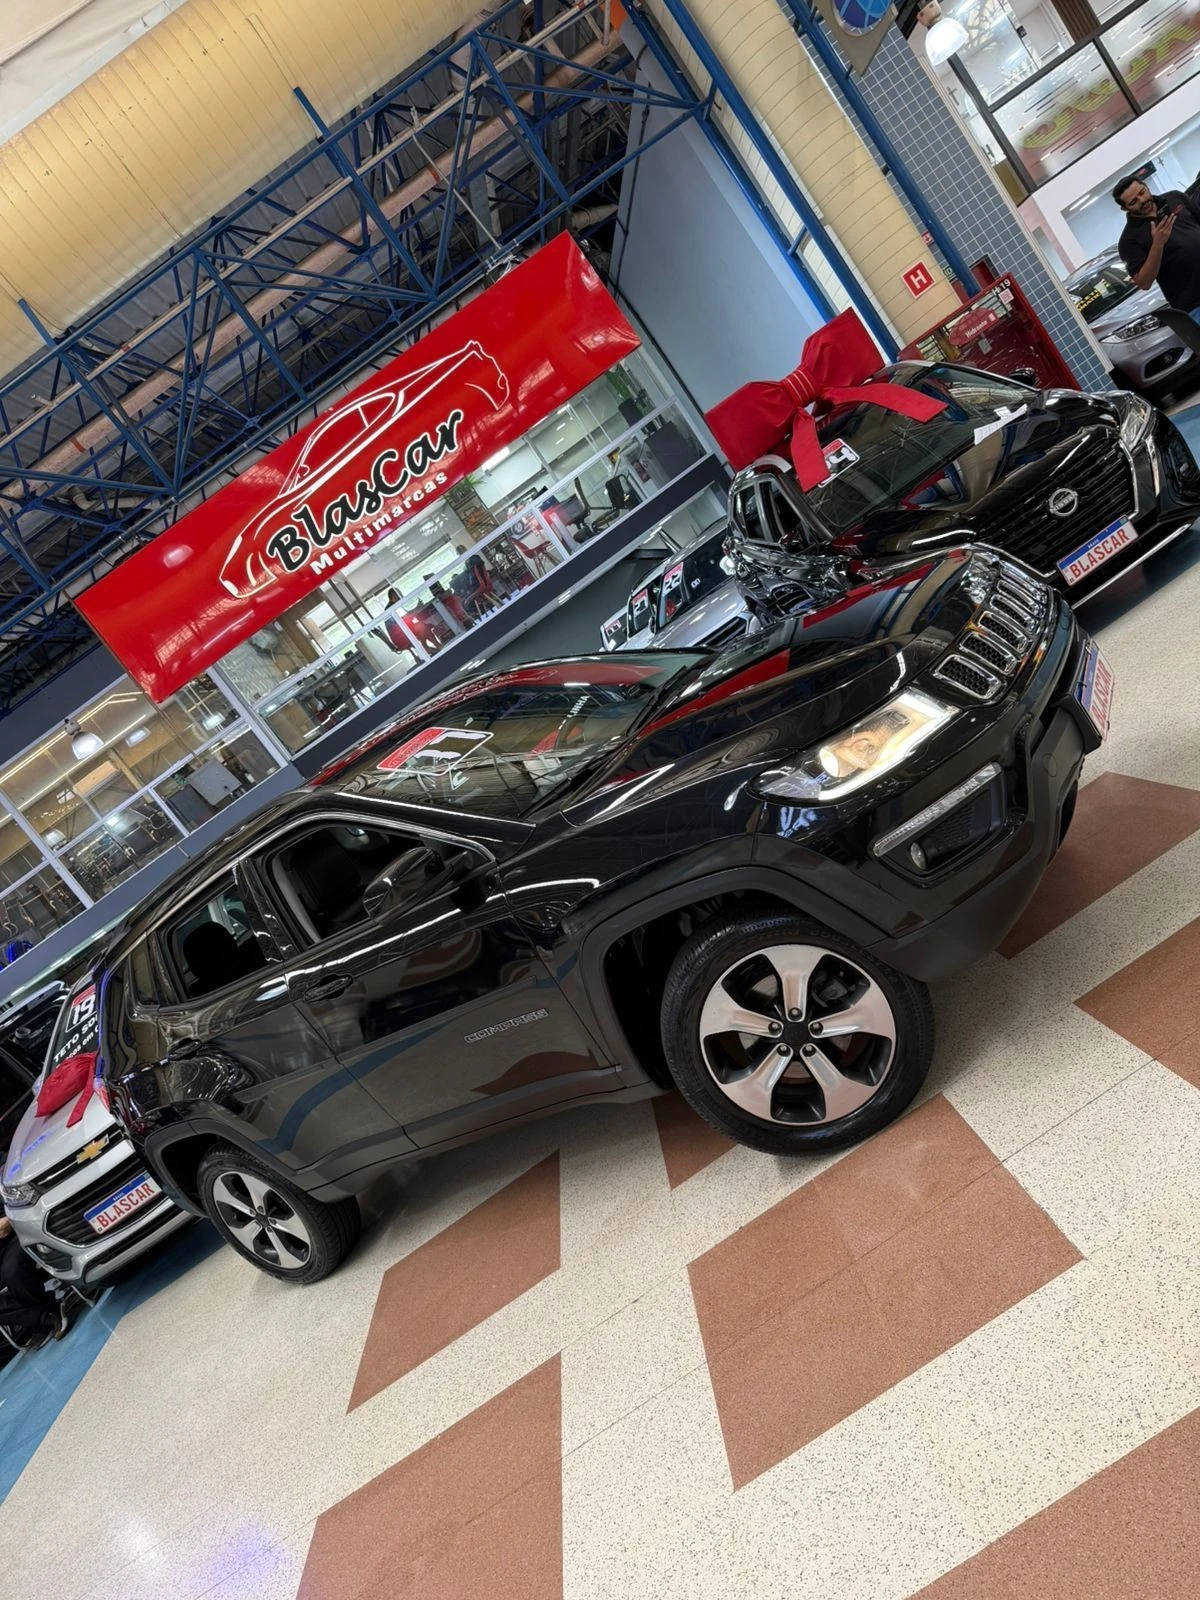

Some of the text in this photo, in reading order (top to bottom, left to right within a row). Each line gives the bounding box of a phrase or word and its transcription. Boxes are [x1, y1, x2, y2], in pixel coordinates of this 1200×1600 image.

[909, 269, 928, 289] H
[965, 320, 988, 338] Hidrante
[266, 408, 464, 573] BlasCar
[309, 471, 448, 575] Multimarcas
[1069, 528, 1130, 578] BLASCAR
[567, 695, 590, 719] LINHA
[1091, 658, 1113, 730] BLASCAR
[72, 994, 96, 1025] 19
[54, 1033, 80, 1062] TETO
[82, 1031, 94, 1045] em
[96, 1182, 155, 1228] BLASCAR
